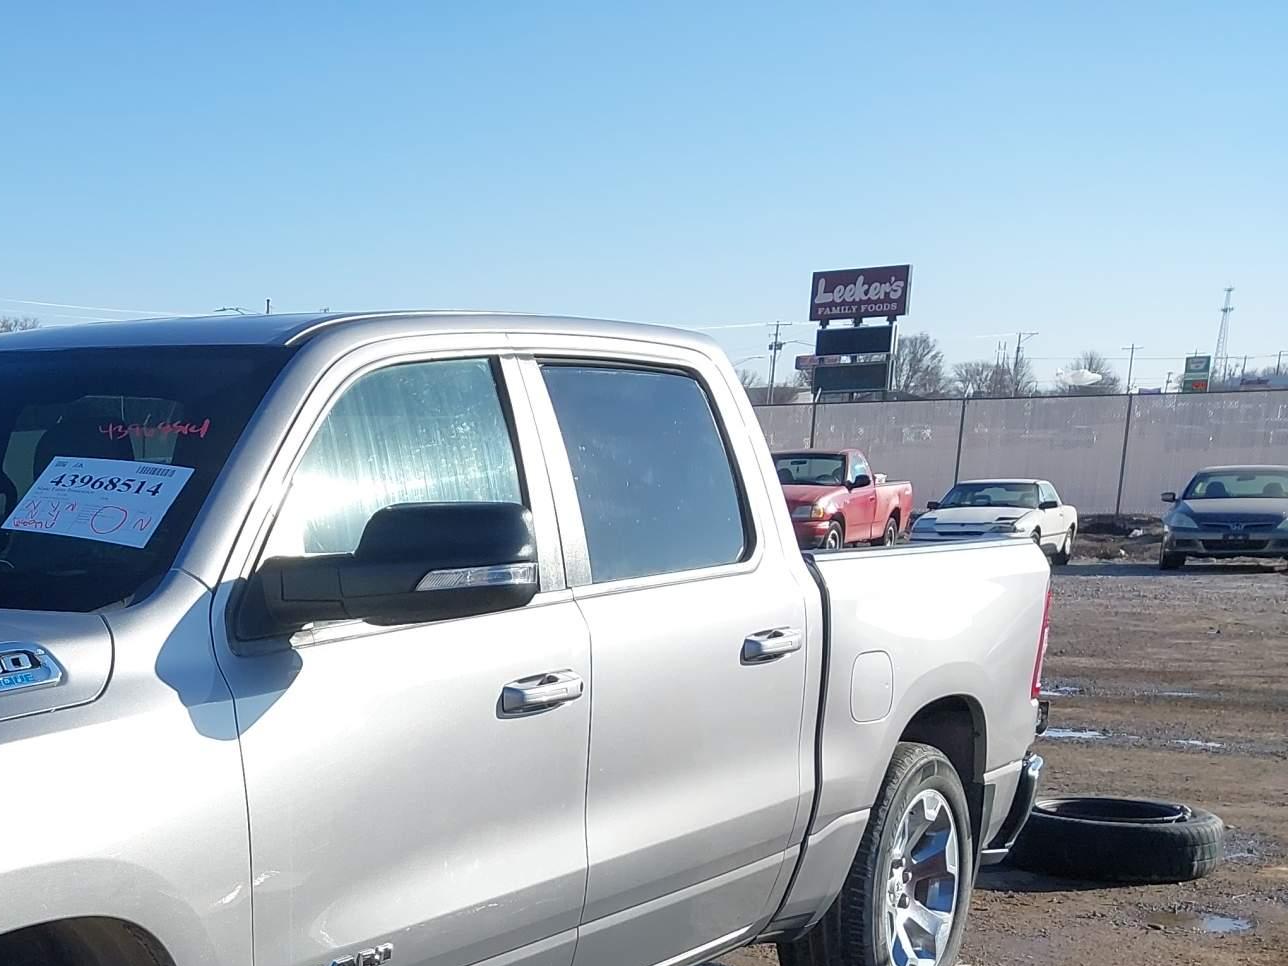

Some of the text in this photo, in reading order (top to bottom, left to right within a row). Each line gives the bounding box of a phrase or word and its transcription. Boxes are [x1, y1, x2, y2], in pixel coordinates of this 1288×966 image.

[814, 275, 905, 304] Leeker's
[818, 302, 898, 315] FAMILY FOODS
[49, 472, 164, 497] 43968514
